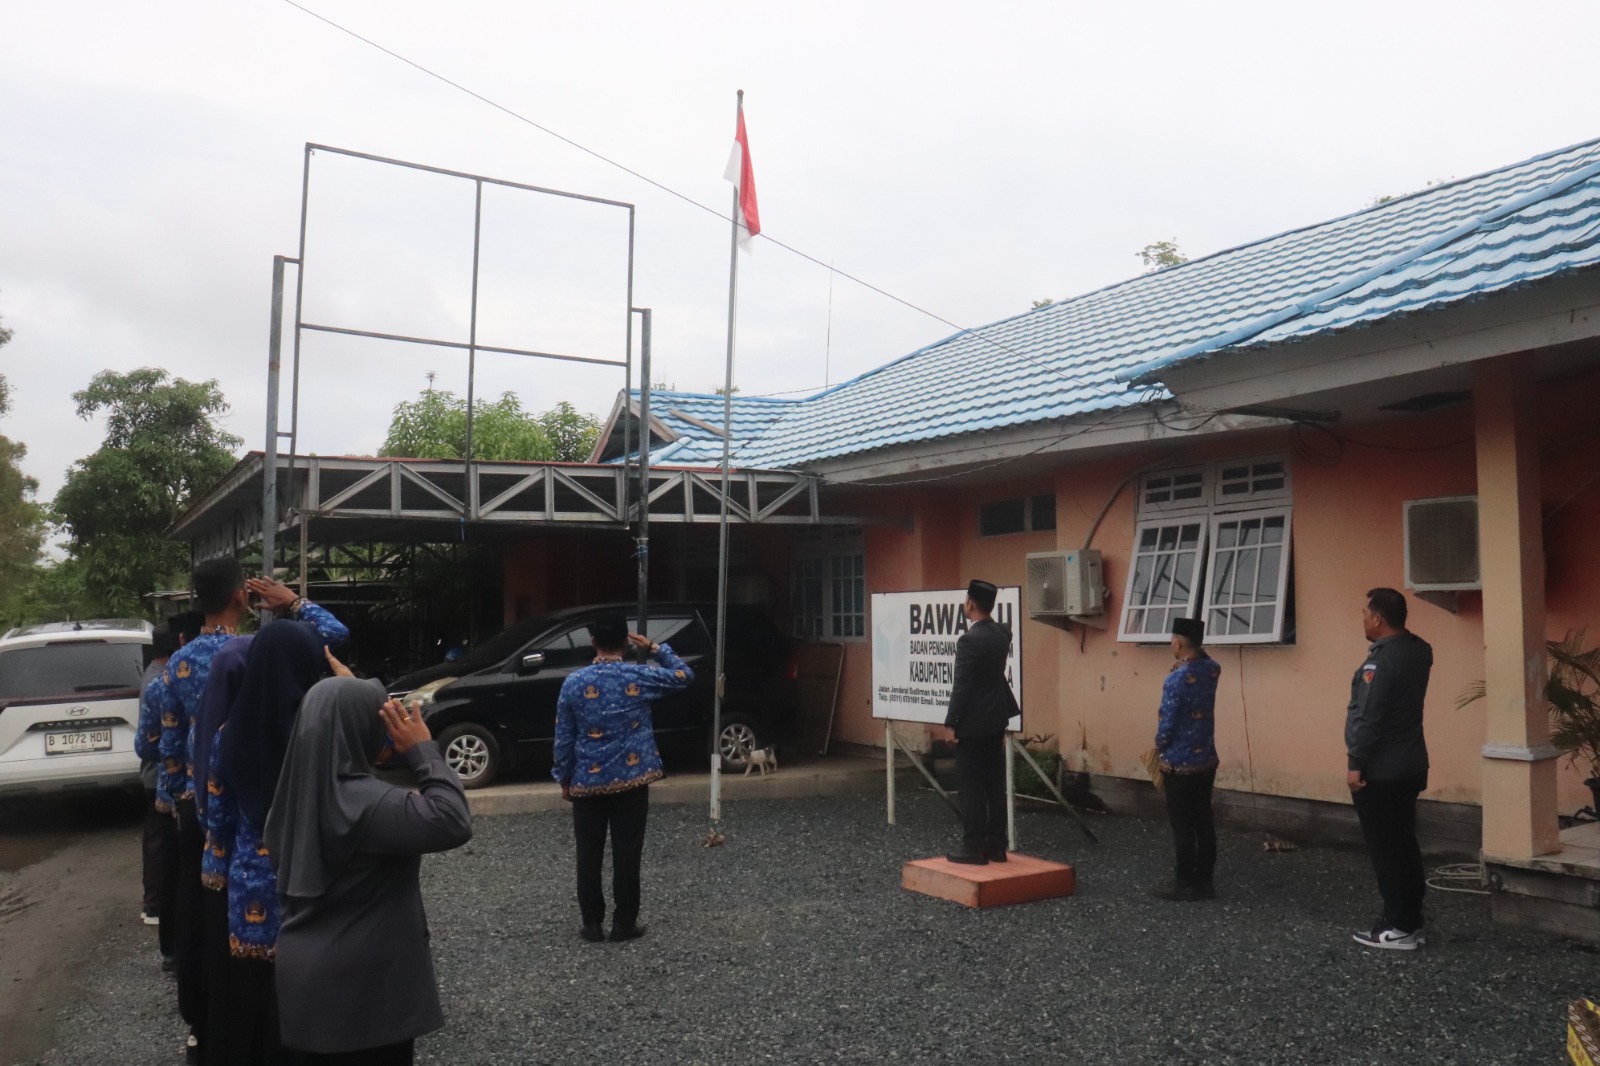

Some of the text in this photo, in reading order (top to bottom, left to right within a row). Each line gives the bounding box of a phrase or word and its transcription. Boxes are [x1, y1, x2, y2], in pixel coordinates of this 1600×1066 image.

[909, 602, 1012, 635] BAWAU
[910, 640, 957, 656] BADAN PENGAWA
[910, 661, 953, 684] KABUPATEN
[878, 685, 890, 693] Jalan
[891, 686, 909, 694] Jenderal
[909, 687, 930, 696] Sudirman
[49, 735, 55, 746] B
[62, 733, 86, 745] 1072
